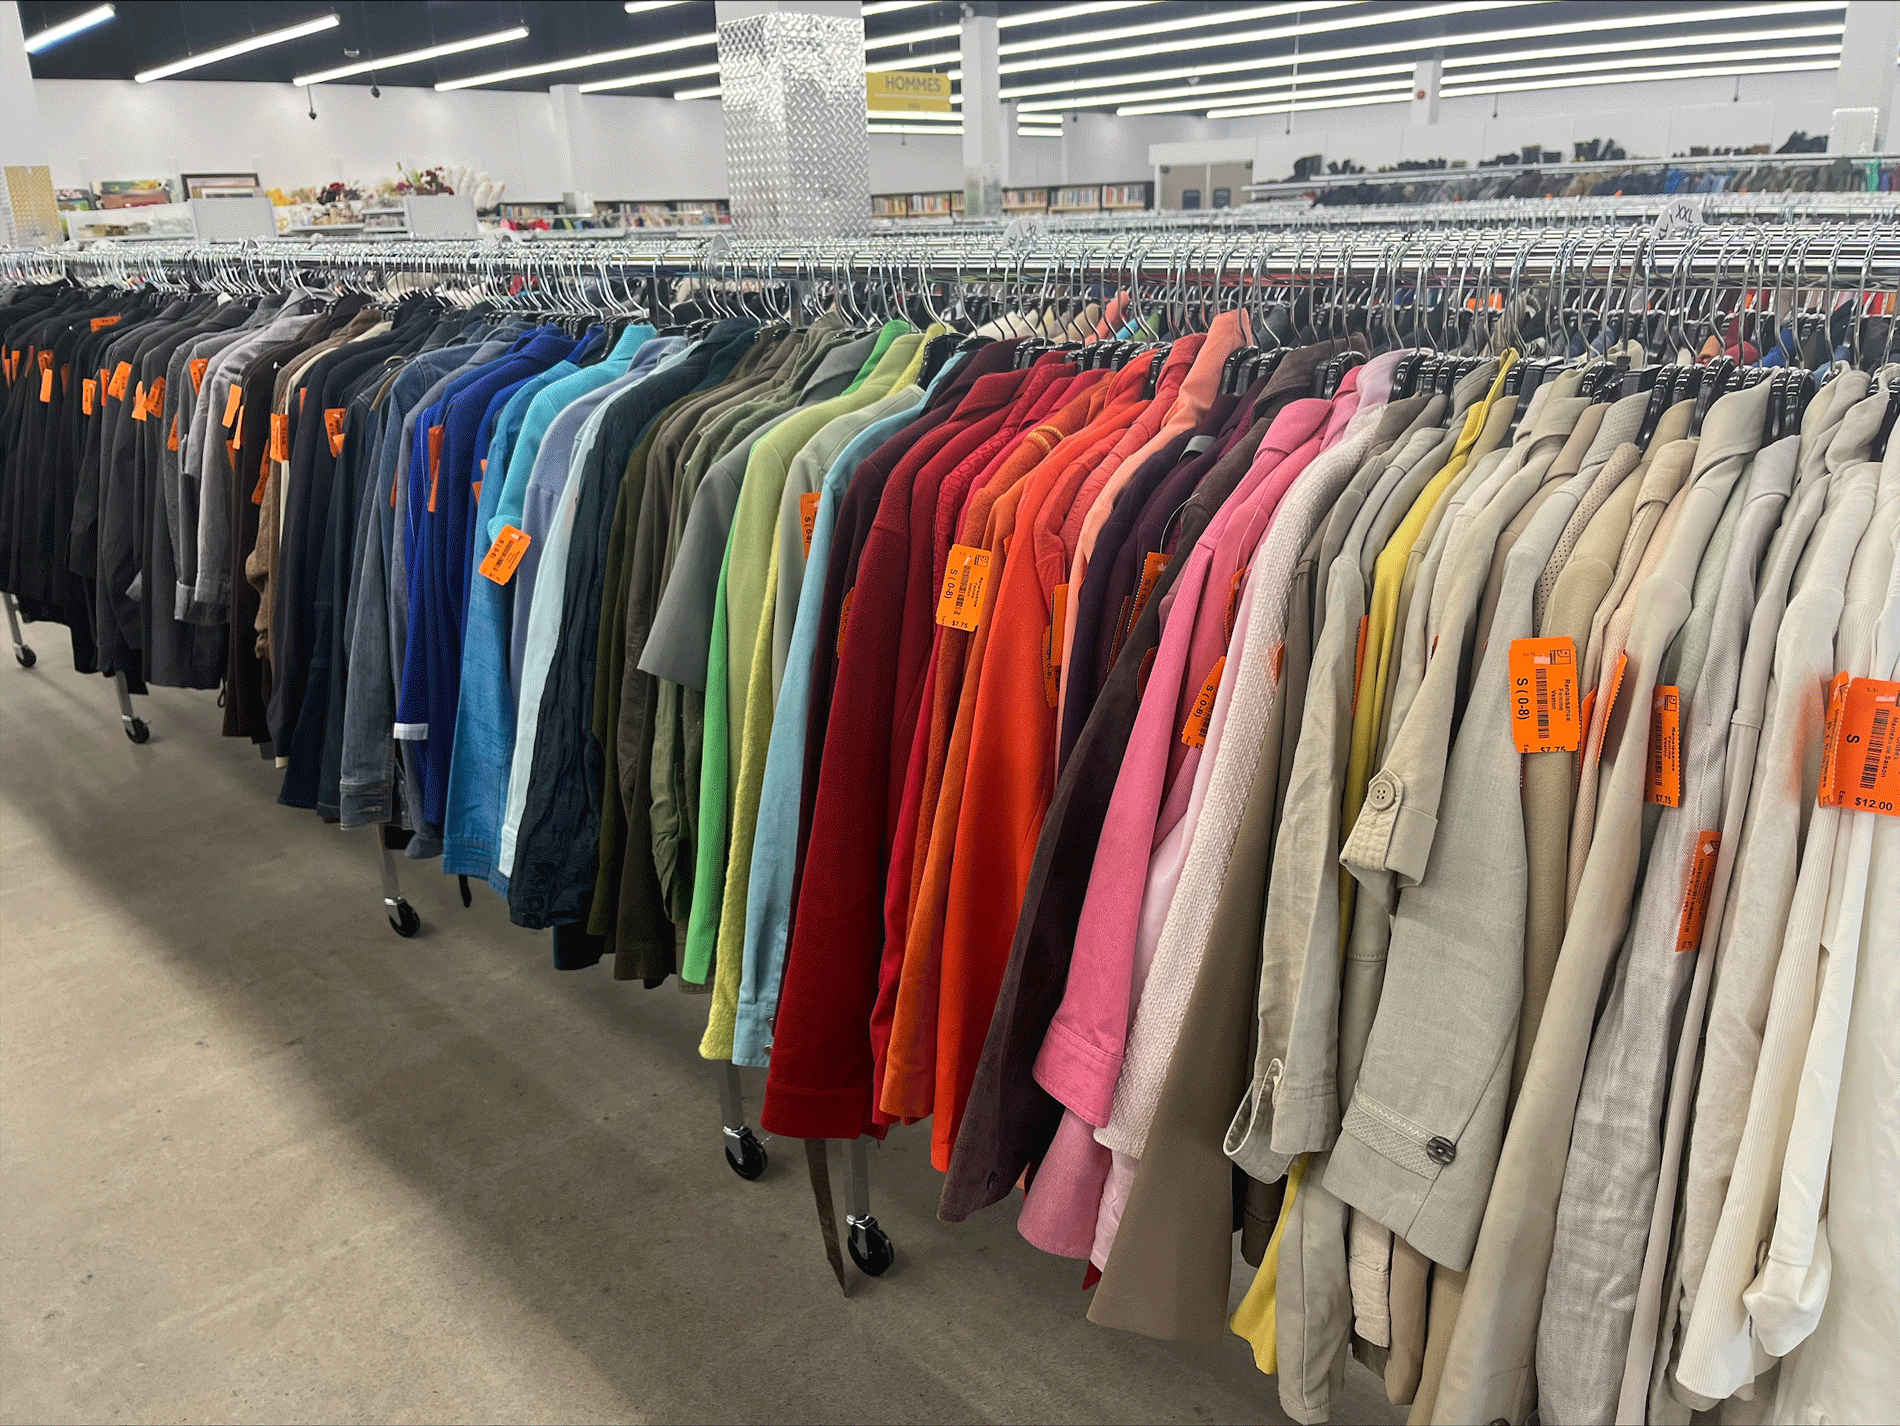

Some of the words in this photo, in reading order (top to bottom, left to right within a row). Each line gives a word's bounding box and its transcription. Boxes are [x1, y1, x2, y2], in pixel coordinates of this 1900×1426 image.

[885, 75, 941, 92] HOMMES
[1675, 204, 1693, 224] XXL
[1516, 677, 1529, 686] S
[1846, 734, 1860, 743] S
[1655, 794, 1672, 805] $7.75
[1854, 797, 1893, 811] $12.00
